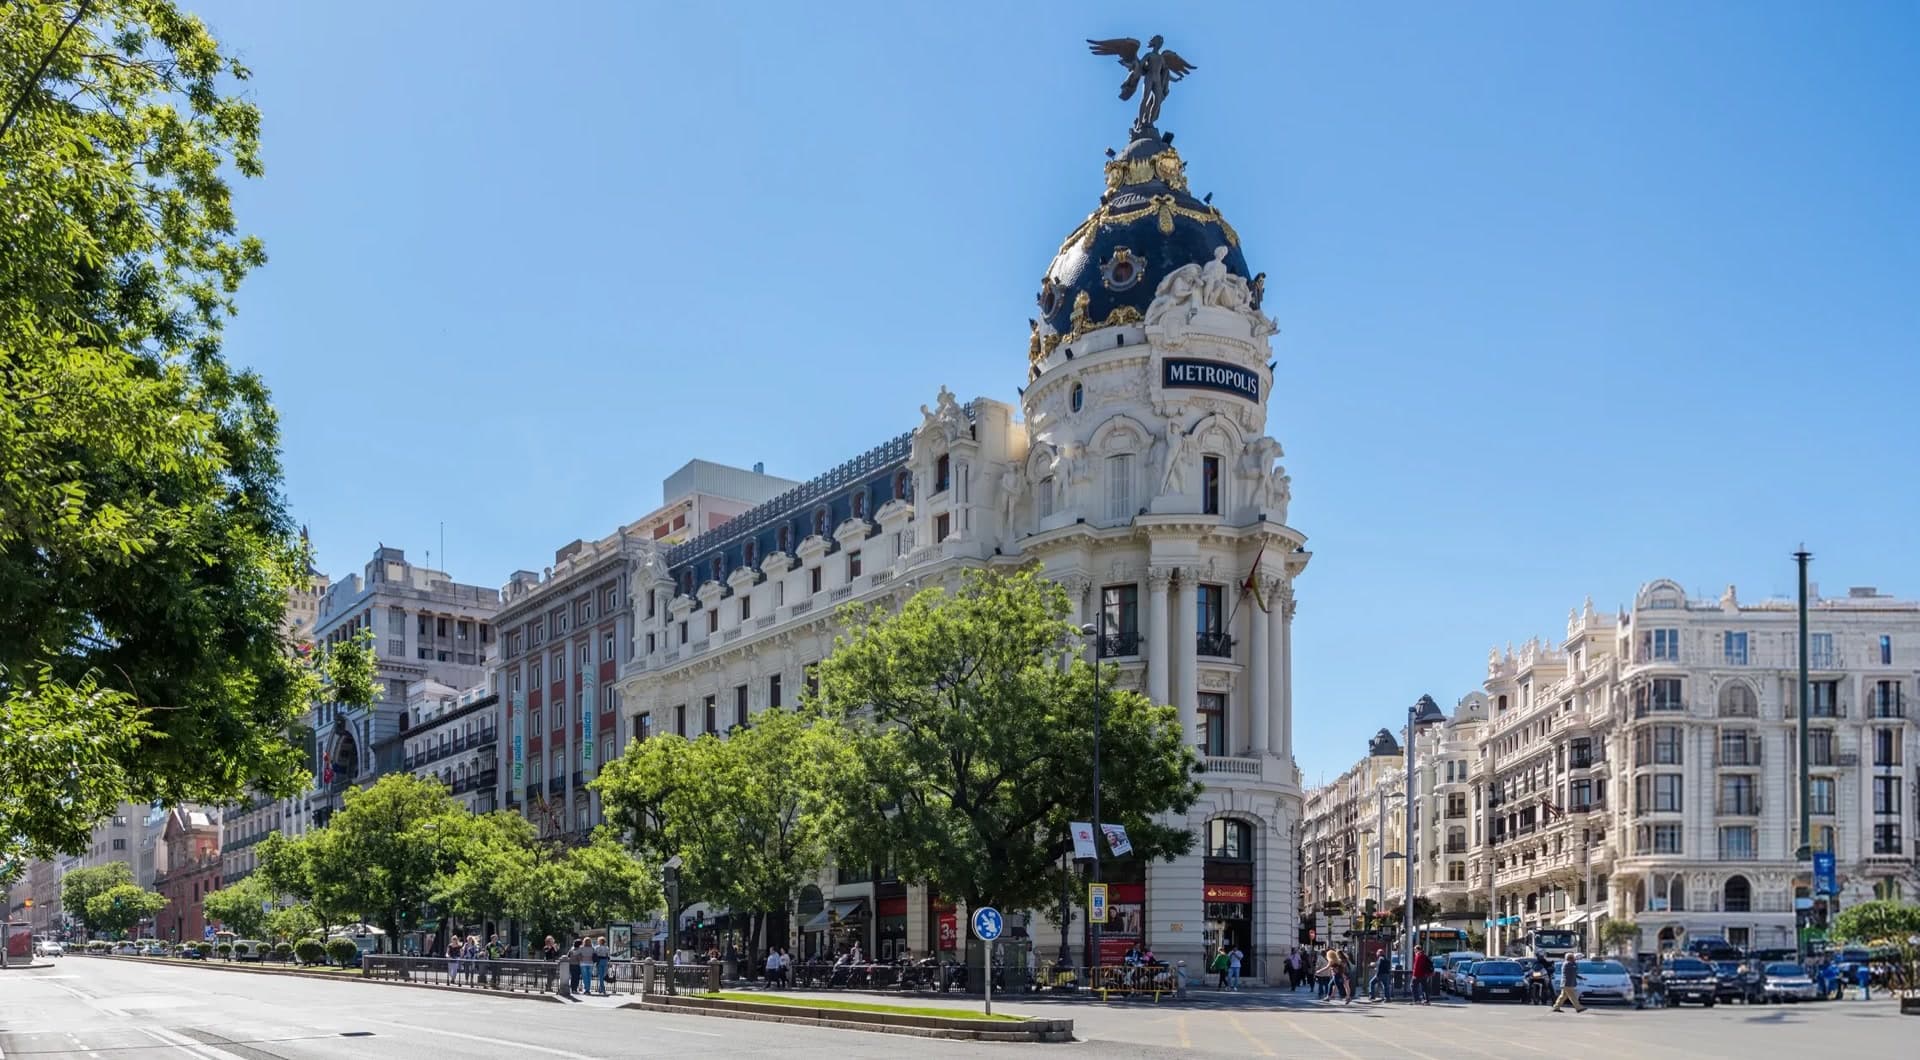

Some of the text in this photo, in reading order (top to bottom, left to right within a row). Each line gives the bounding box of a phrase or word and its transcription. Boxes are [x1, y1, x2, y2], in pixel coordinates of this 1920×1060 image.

[1170, 364, 1257, 394] METROPOLIS
[513, 735, 522, 761] salida
[514, 763, 524, 779] hay
[1217, 888, 1248, 897] Santander
